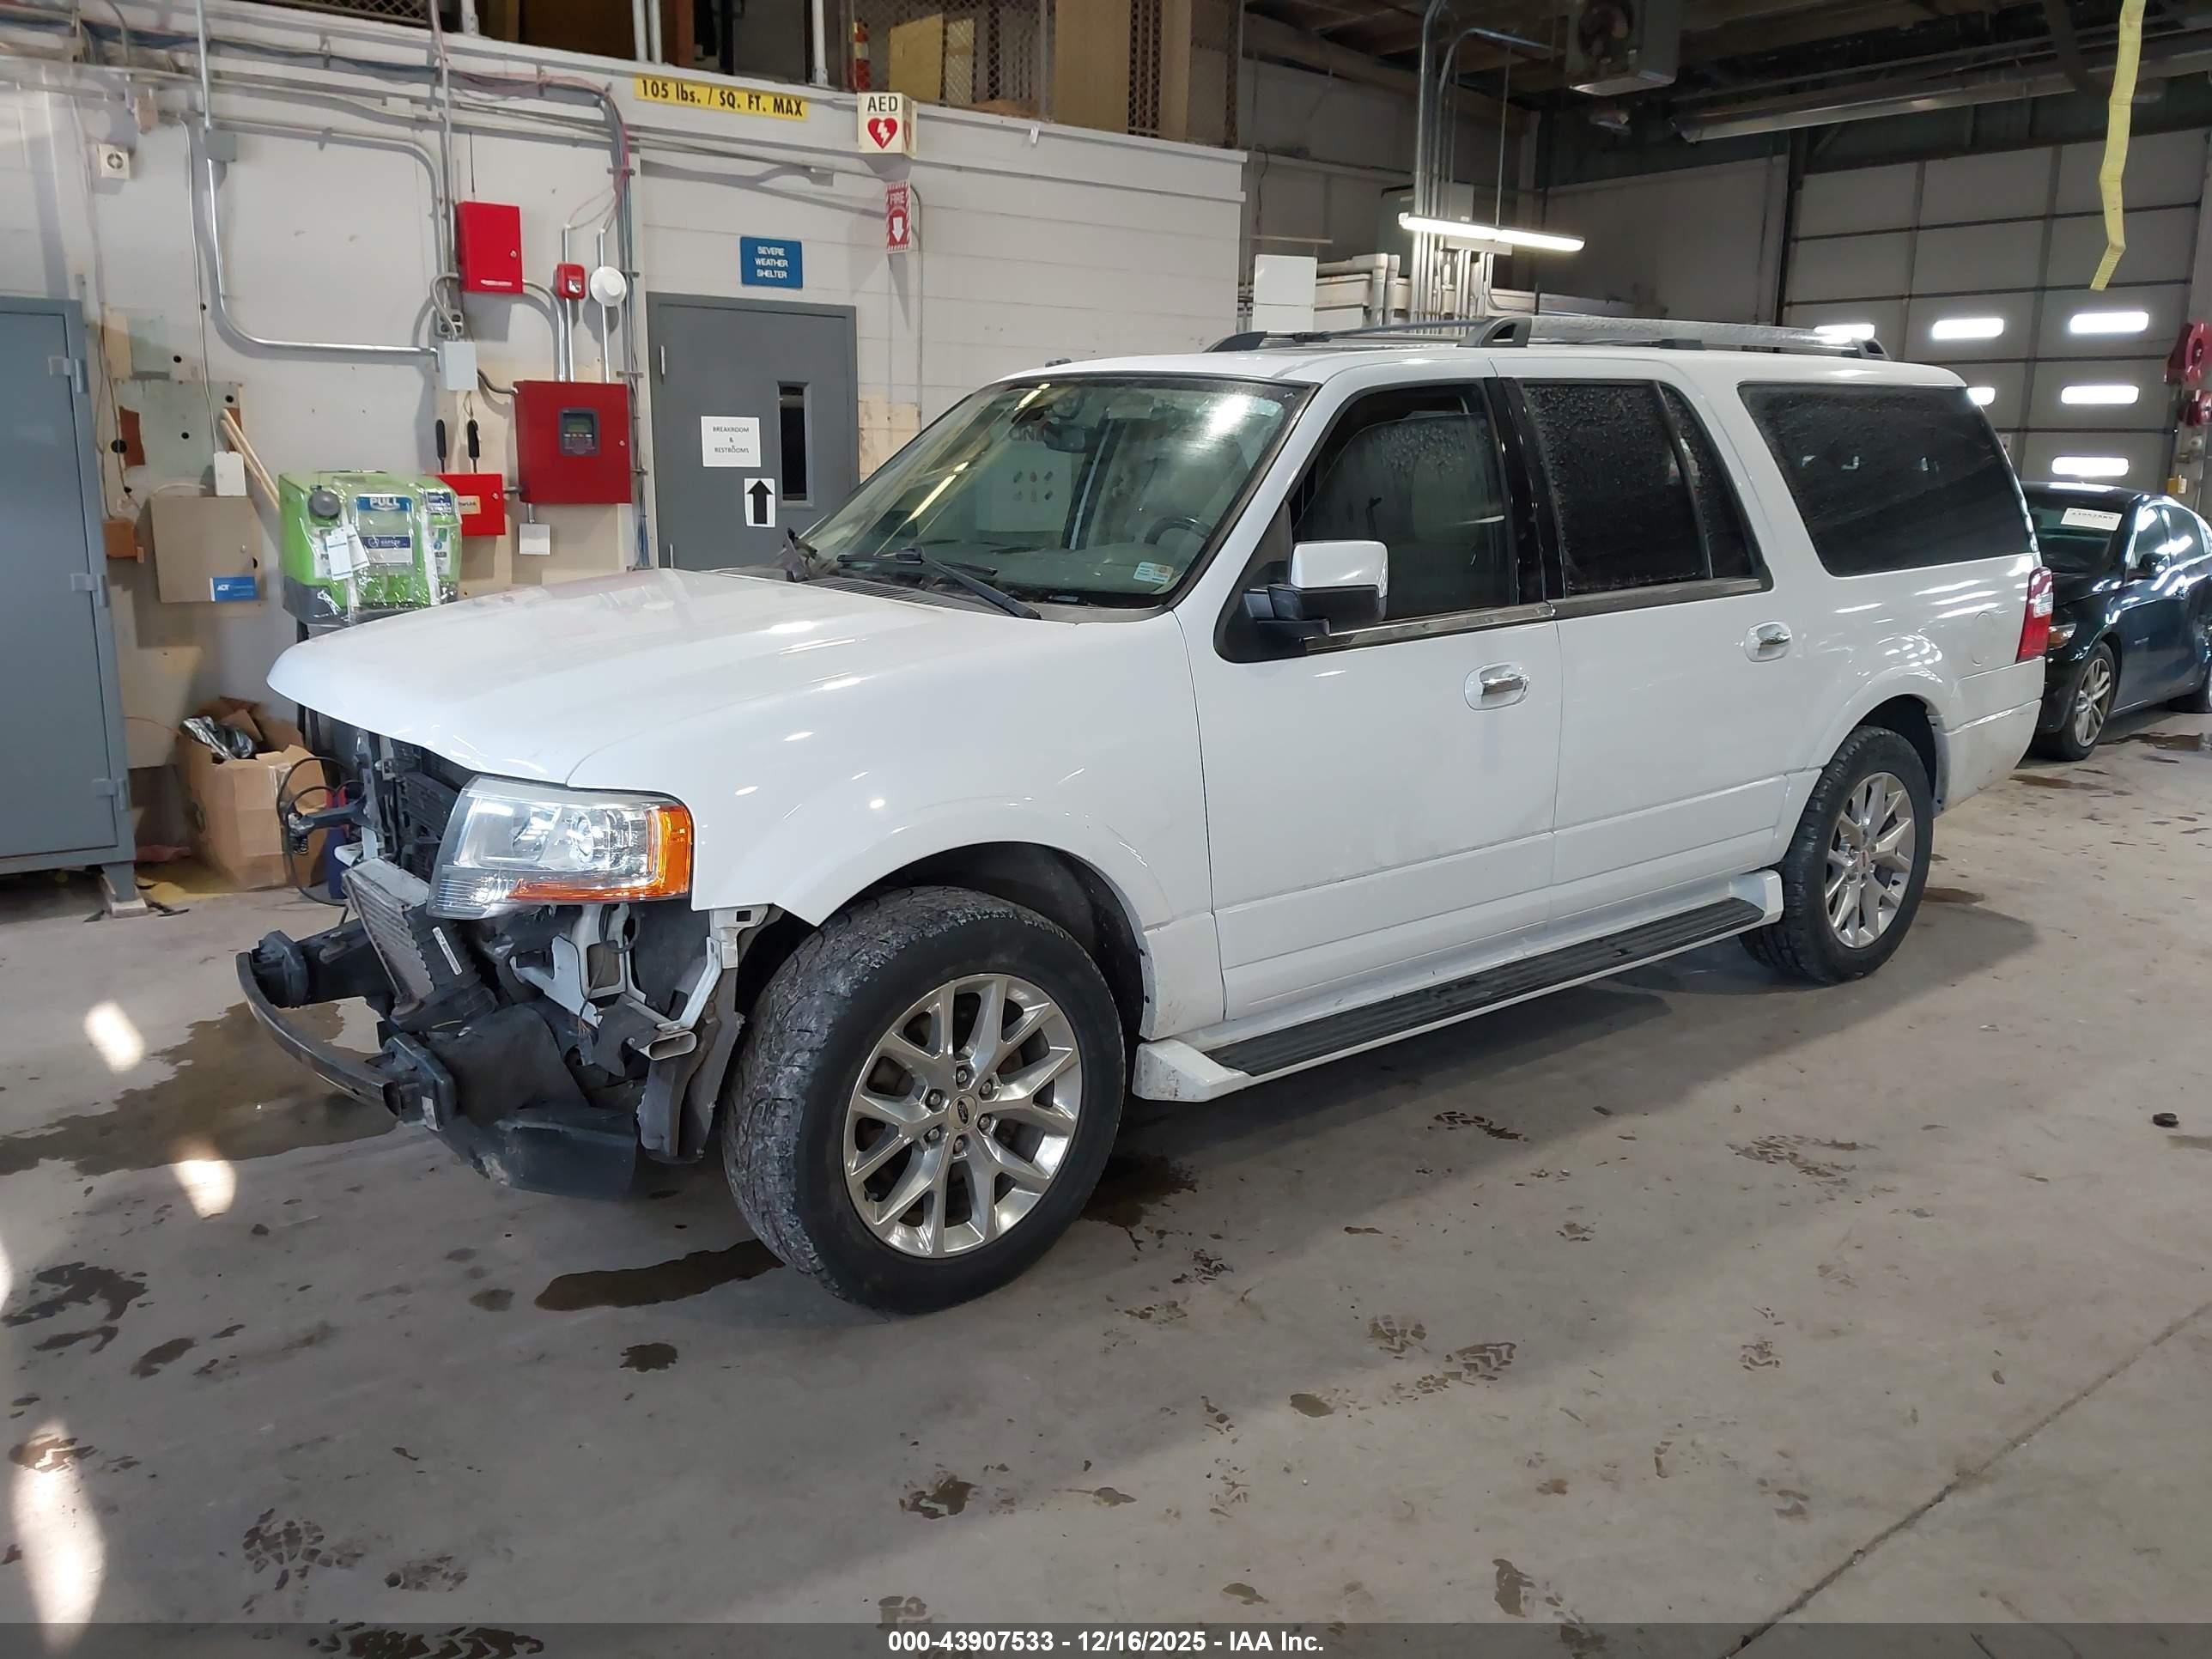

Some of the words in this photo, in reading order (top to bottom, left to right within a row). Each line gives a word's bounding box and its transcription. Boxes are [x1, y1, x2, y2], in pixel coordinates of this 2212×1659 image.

[641, 80, 669, 98] 105
[676, 82, 701, 104] lbs.
[708, 87, 713, 105] /
[720, 90, 741, 109] SQ.
[748, 94, 767, 112] FT.
[773, 98, 803, 117] MAX
[867, 96, 898, 112] AED
[890, 191, 905, 206] FIRE
[757, 246, 785, 256] SEVERE
[755, 258, 788, 267] WEATHER
[756, 269, 787, 278] SHELTER
[370, 496, 400, 508] PULL
